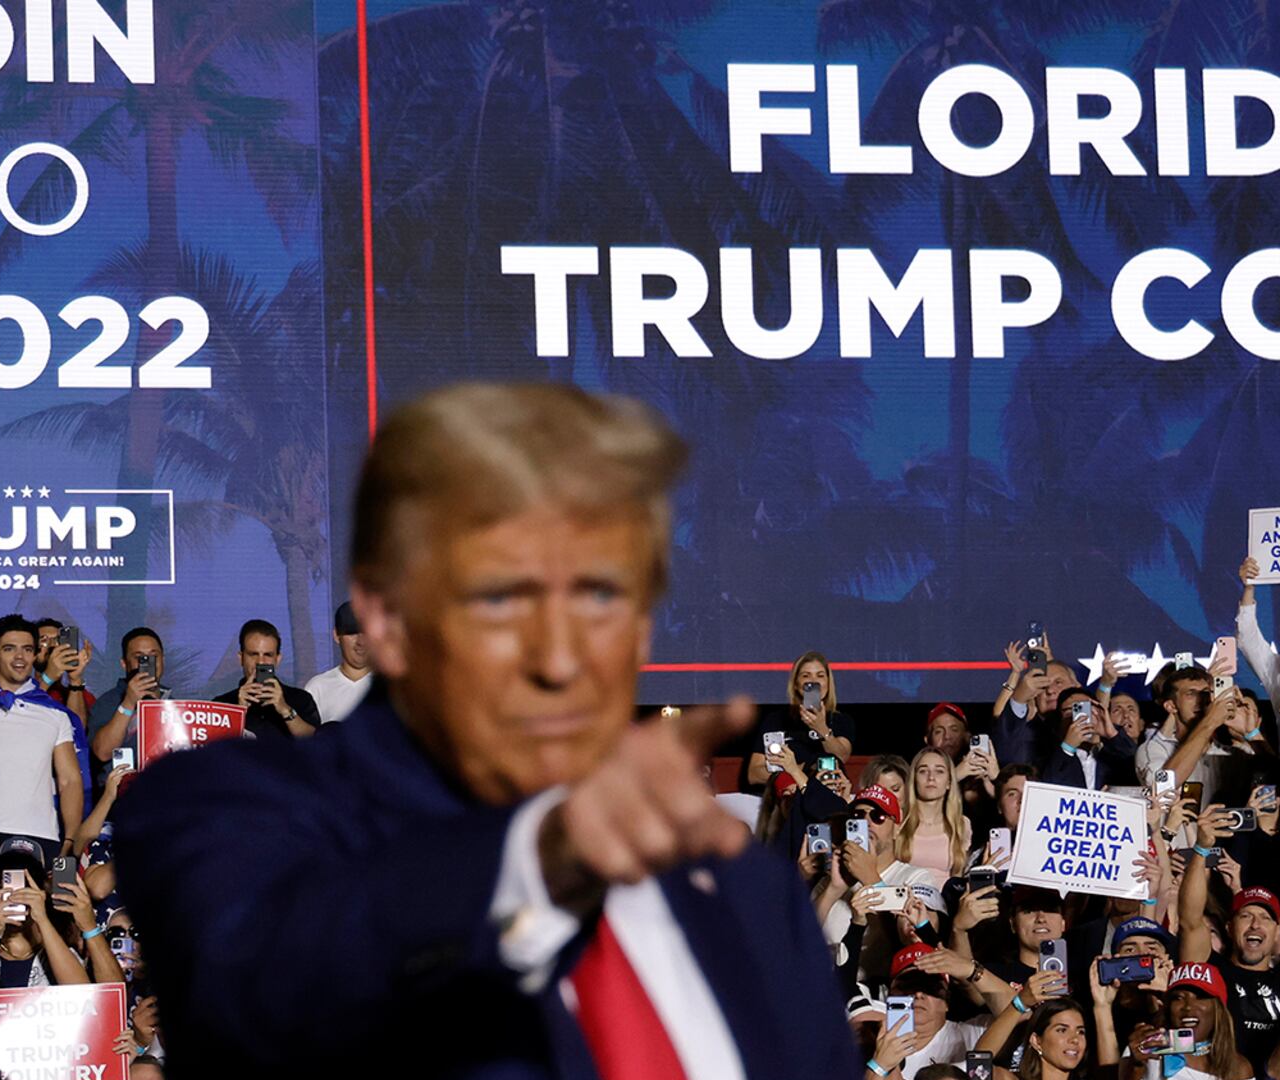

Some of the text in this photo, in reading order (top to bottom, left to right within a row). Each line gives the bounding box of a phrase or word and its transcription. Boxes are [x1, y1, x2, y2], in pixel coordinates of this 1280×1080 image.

[500, 245, 1064, 361] TRUMP
[18, 556, 67, 567] GREAT
[72, 555, 125, 567] AGAIN!
[160, 709, 231, 729] FORIDA
[191, 727, 208, 741] IS
[1058, 797, 1118, 822] MAKE
[1036, 815, 1135, 844] AMERICA
[1047, 836, 1122, 861] GREAT
[1040, 856, 1121, 882] AGAIN!
[1167, 963, 1213, 985] MAGA
[36, 1023, 57, 1041] IS
[7, 1042, 90, 1063] TRUMP
